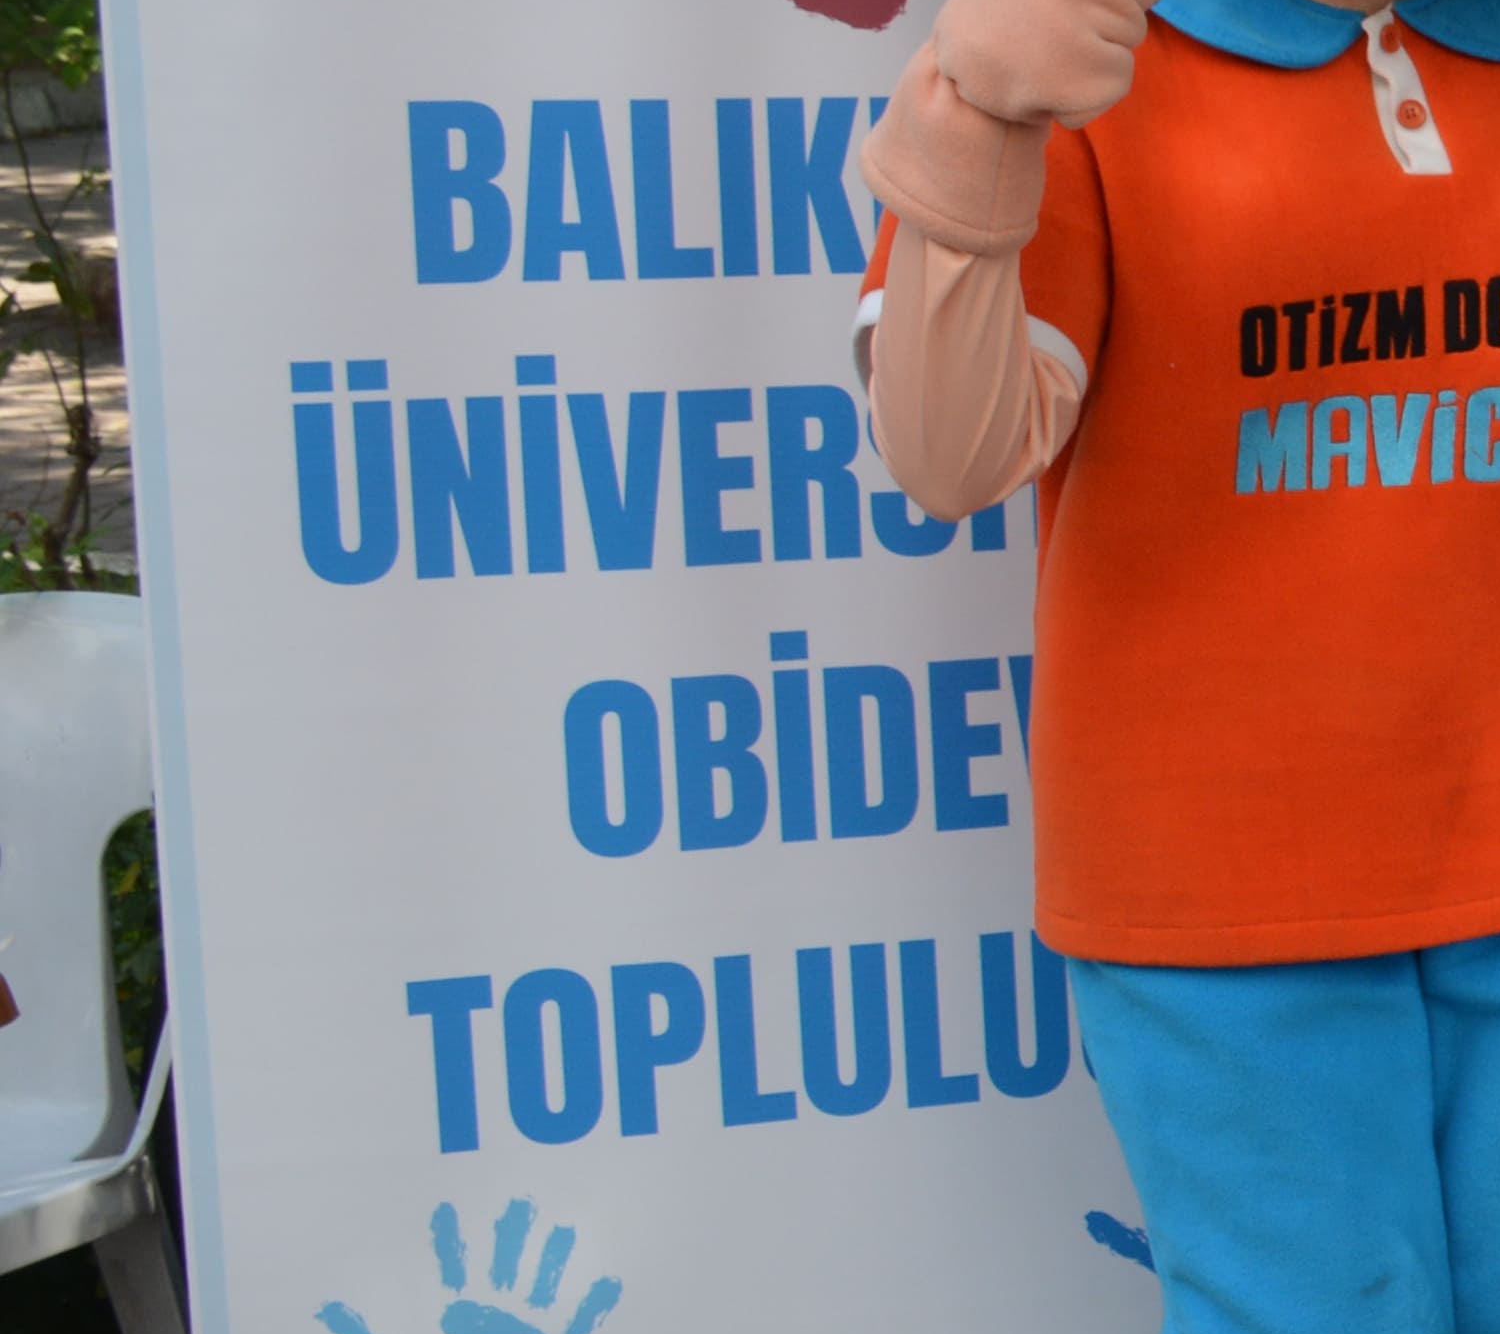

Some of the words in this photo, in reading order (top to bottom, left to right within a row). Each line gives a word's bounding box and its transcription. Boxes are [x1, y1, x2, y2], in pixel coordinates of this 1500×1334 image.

[405, 96, 893, 286] BALIK
[1239, 284, 1427, 379] OTİZM
[288, 353, 1038, 586] ÜNİVER
[562, 630, 1035, 859] OBİDE
[405, 928, 1103, 1155] TOPLULU
